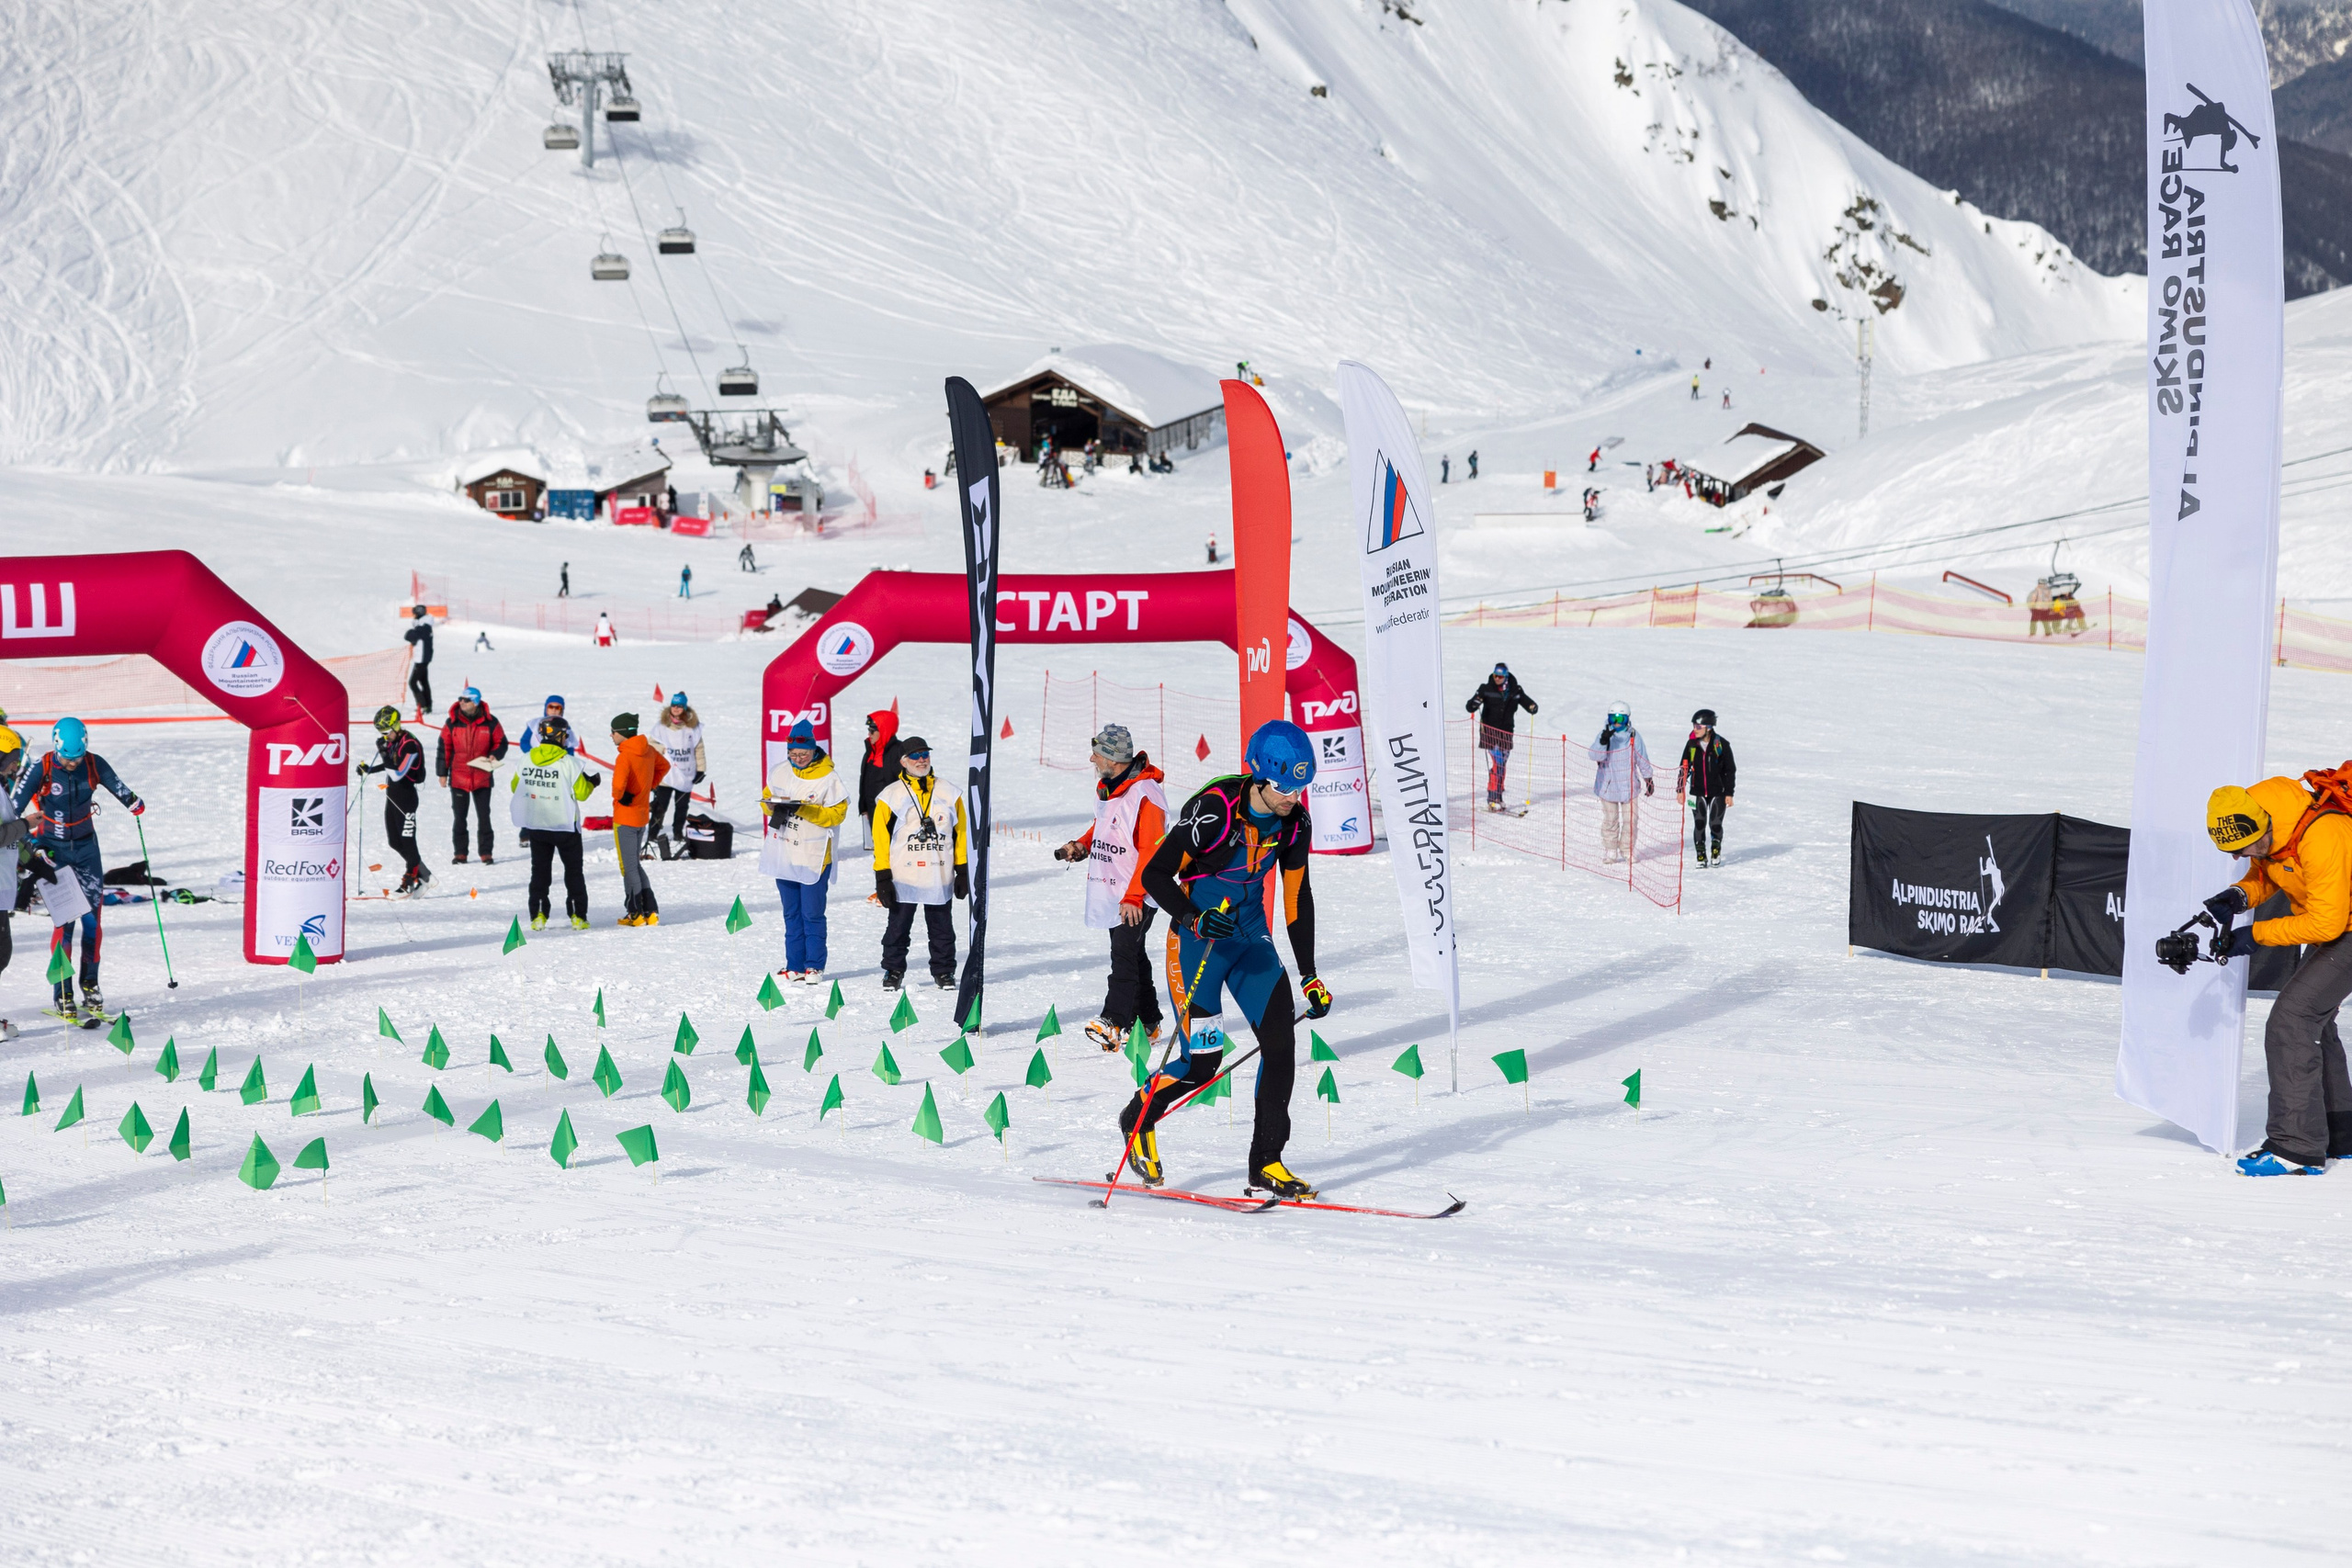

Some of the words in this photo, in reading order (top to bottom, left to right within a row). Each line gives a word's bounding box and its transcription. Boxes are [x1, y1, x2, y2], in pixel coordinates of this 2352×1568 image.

[995, 591, 1148, 632] СТАРТ
[522, 767, 559, 779] СУДЬЯ
[525, 779, 557, 788] REFEREE
[401, 812, 415, 838] RUS
[2216, 814, 2234, 827] THE
[2208, 824, 2238, 837] NORTH
[1323, 832, 1355, 843] VENTO
[2215, 832, 2242, 844] FACE
[1893, 878, 1982, 915] ALPINDUSTRIA
[1917, 909, 1956, 936] SKIMO
[1960, 915, 1985, 937] RACE
[1199, 1030, 1217, 1046] 16
